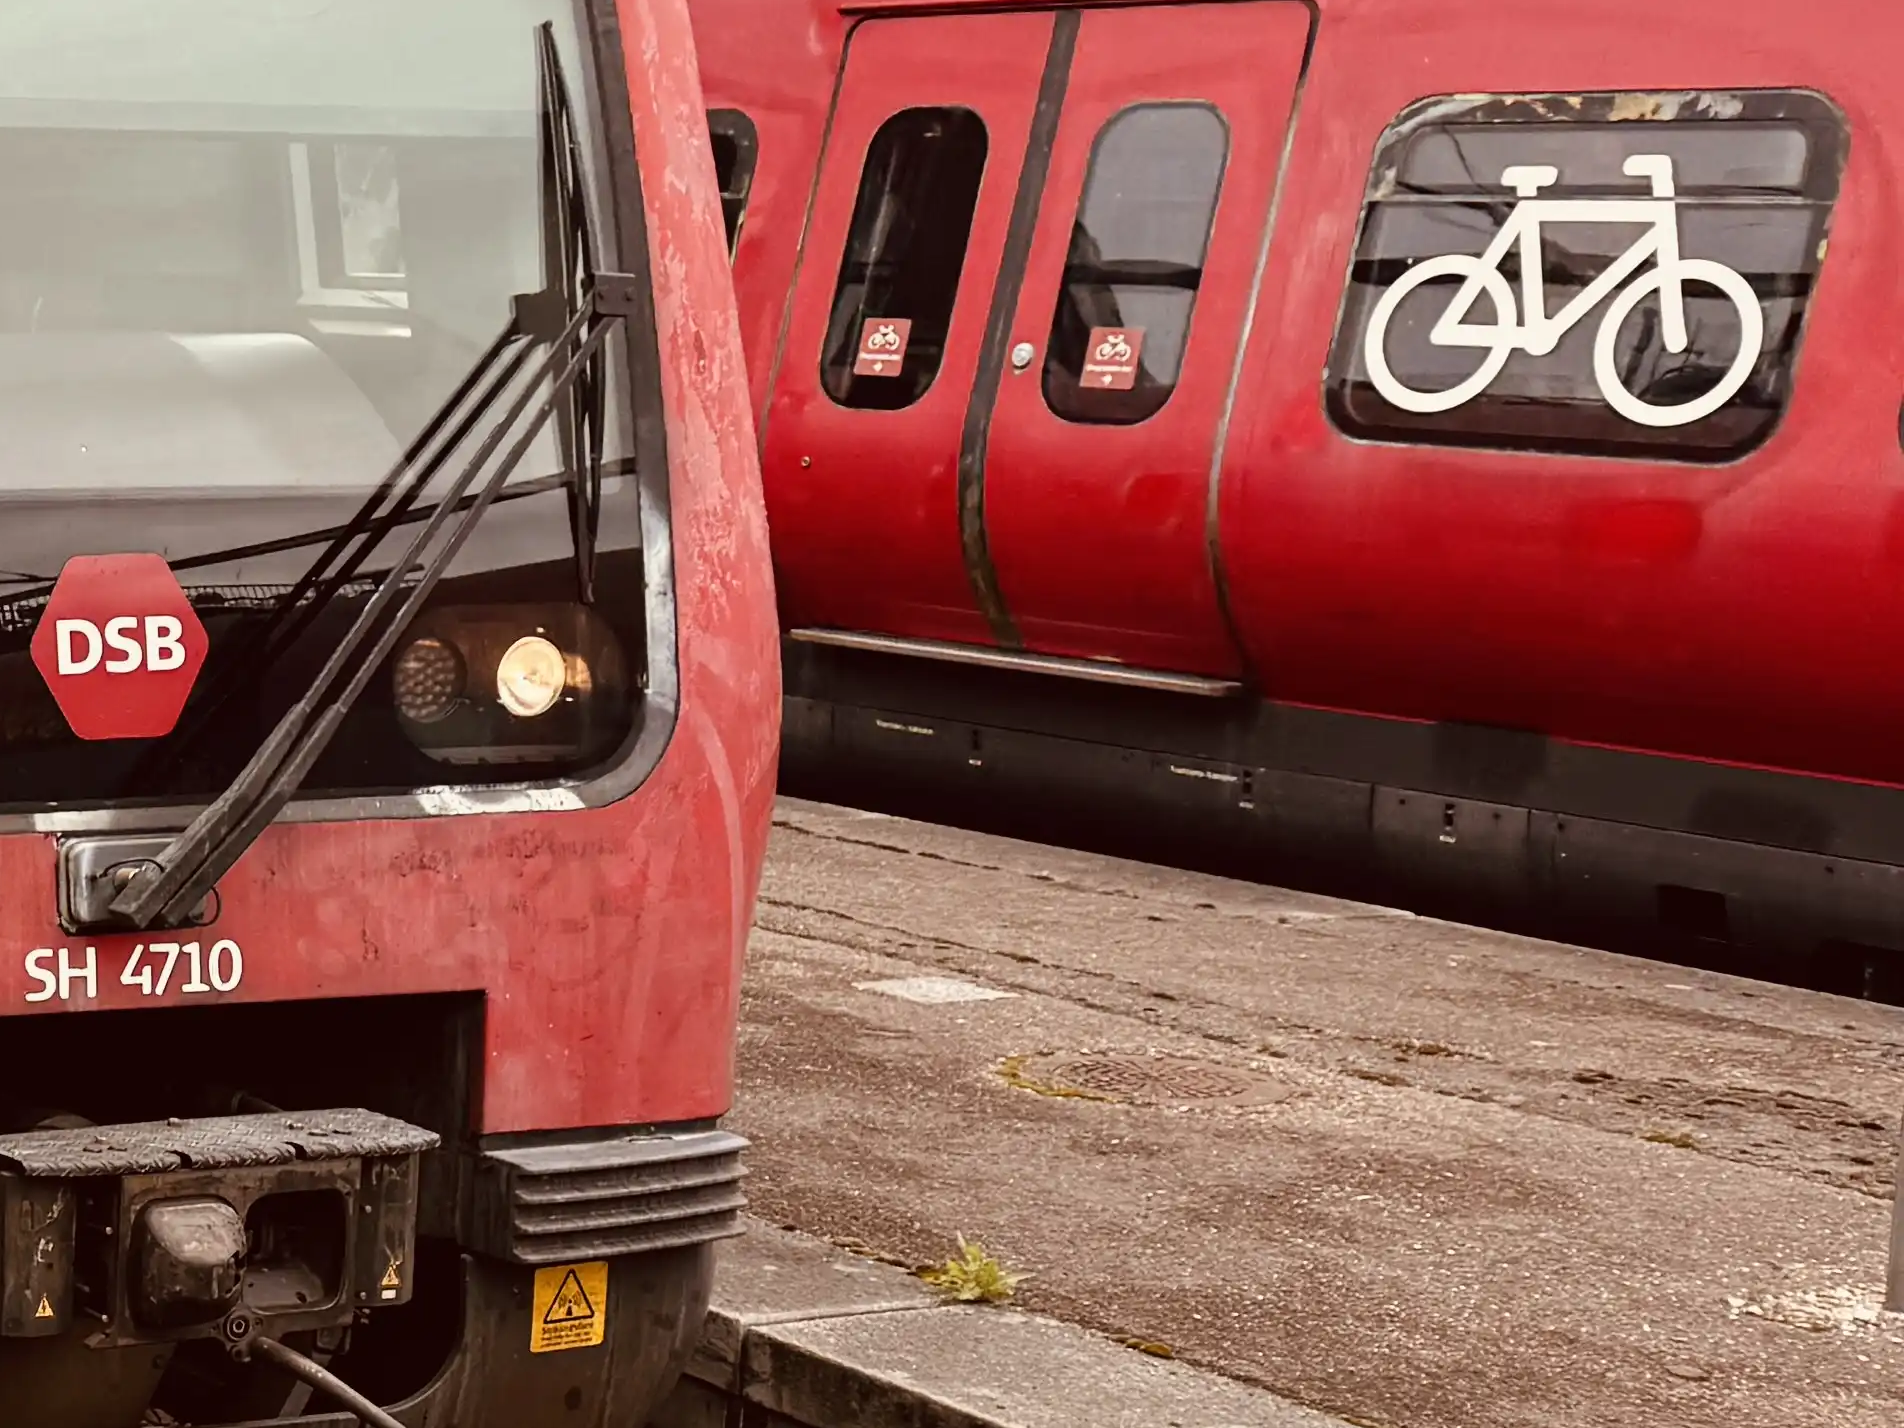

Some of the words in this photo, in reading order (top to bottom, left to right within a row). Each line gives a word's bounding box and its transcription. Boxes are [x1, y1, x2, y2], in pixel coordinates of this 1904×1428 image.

[55, 615, 187, 676] DSB
[24, 948, 97, 1002] SH
[119, 939, 243, 996] 4710
